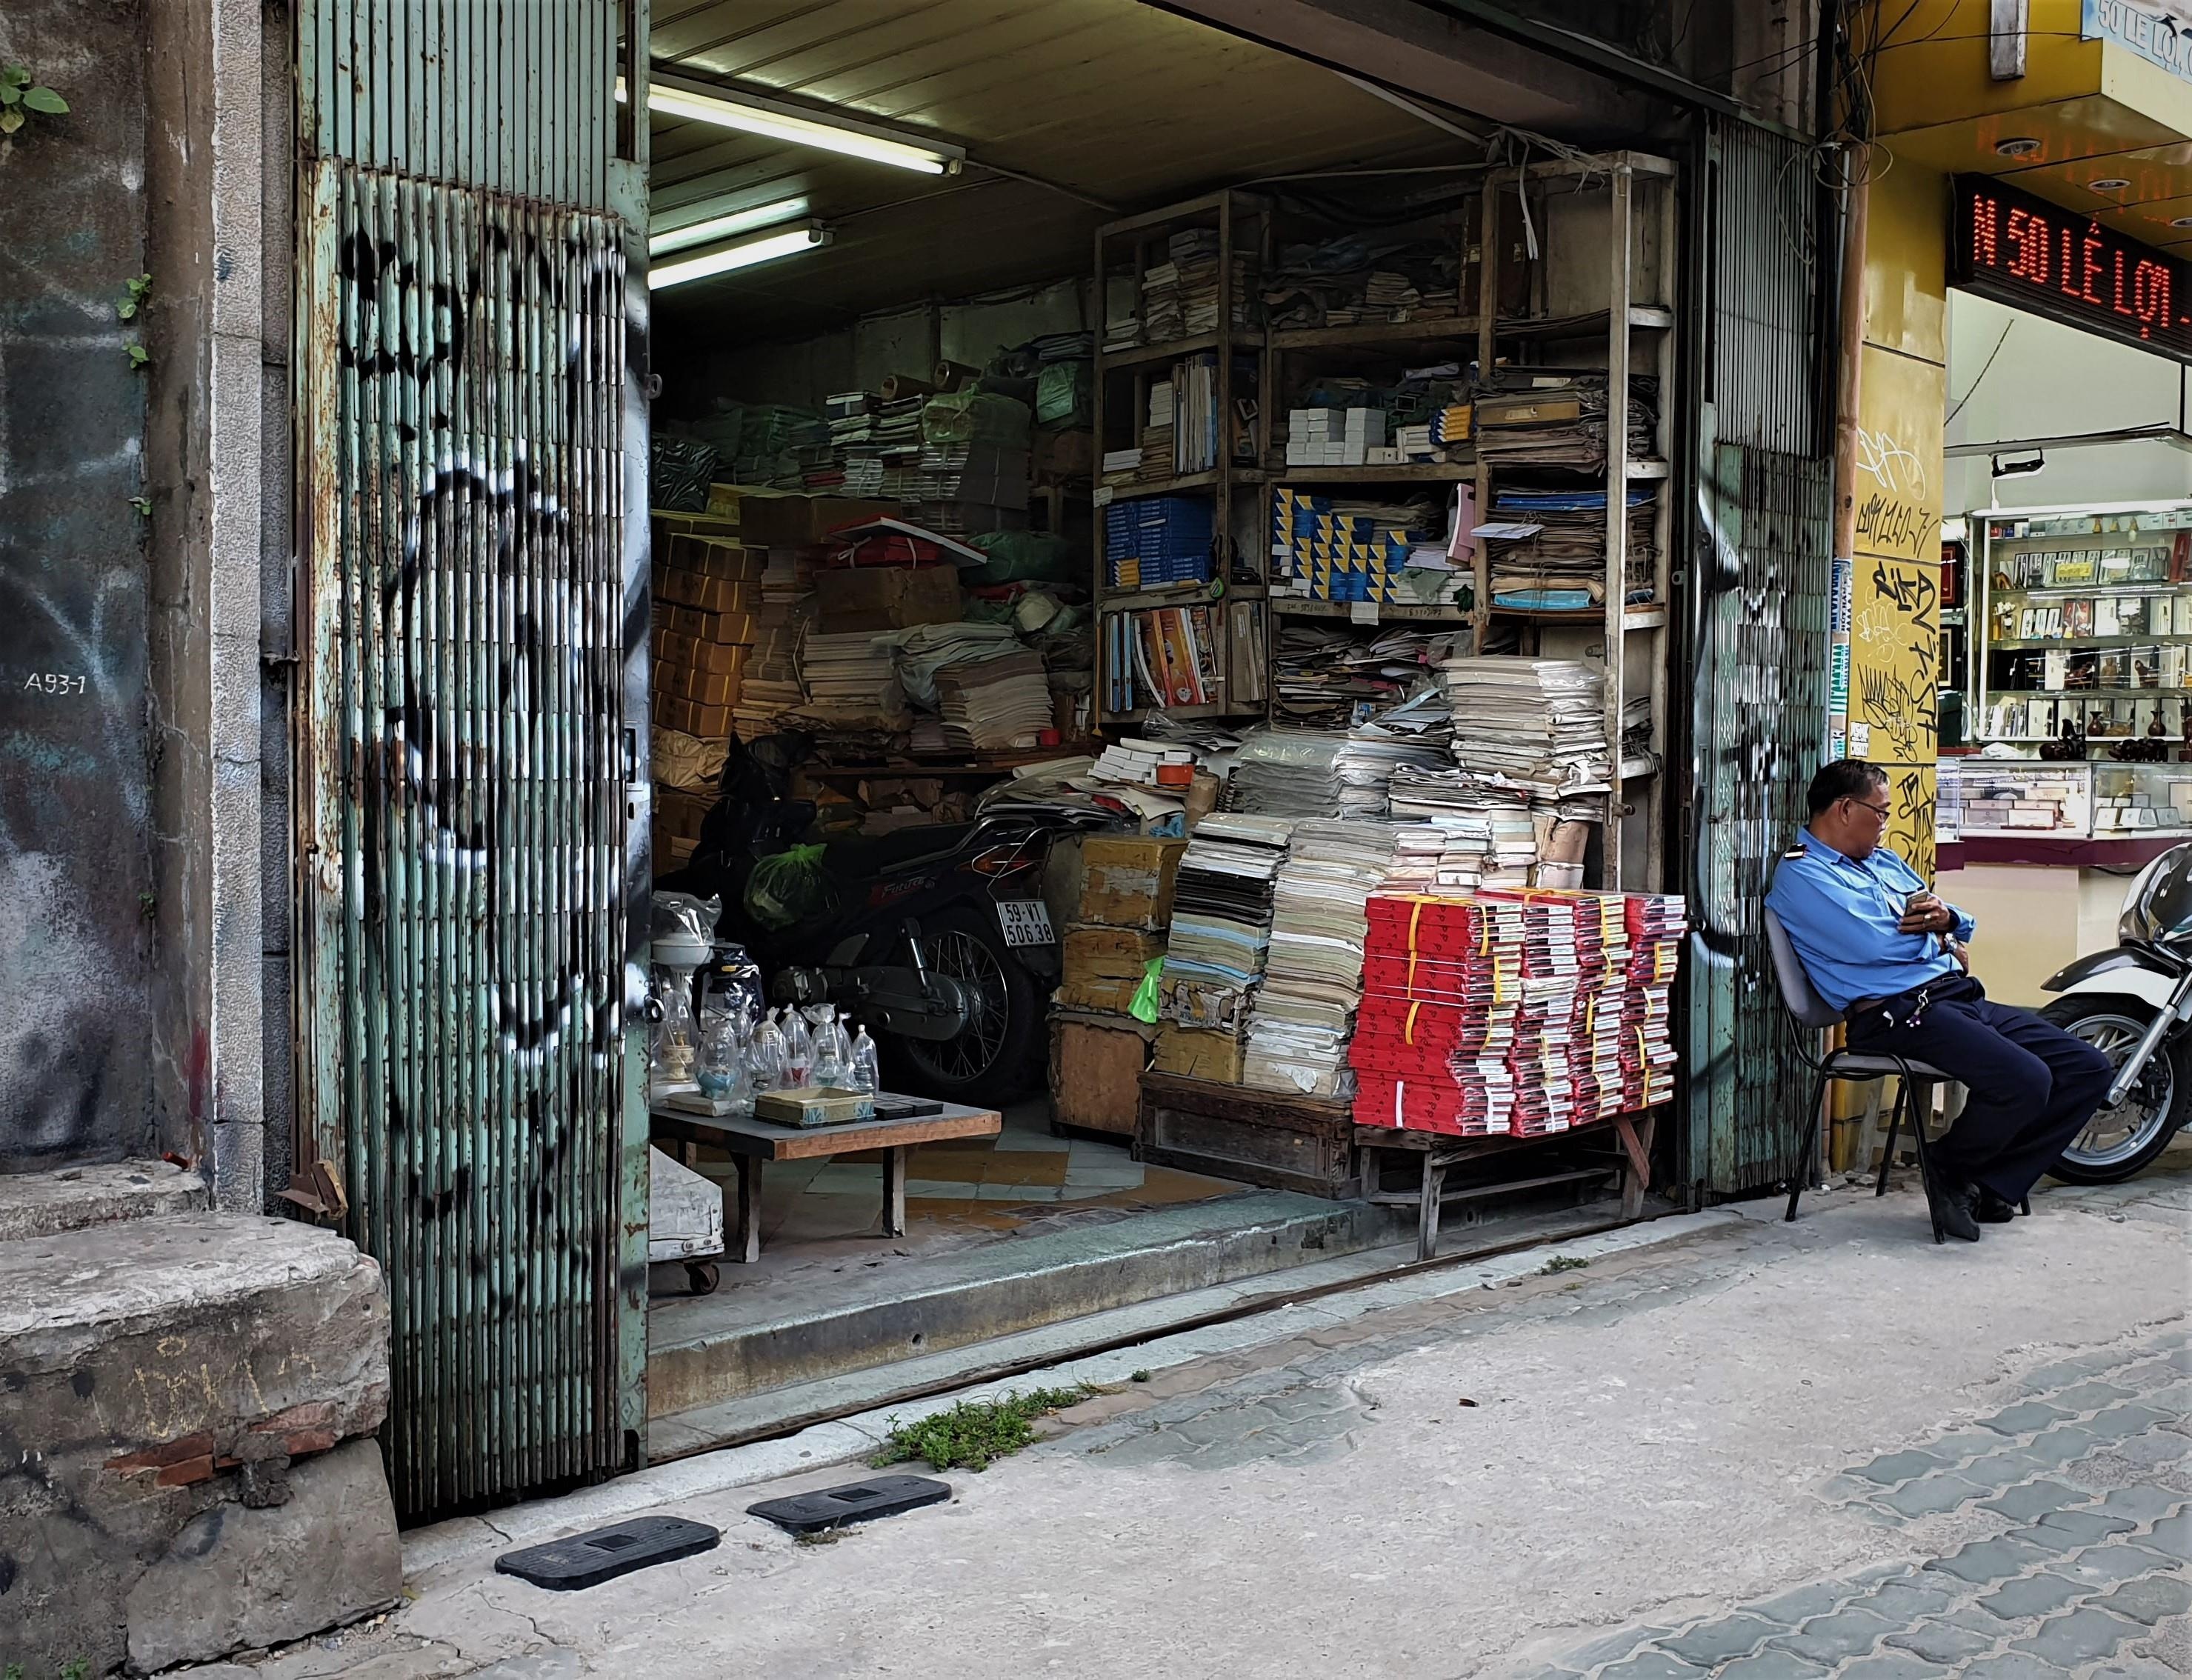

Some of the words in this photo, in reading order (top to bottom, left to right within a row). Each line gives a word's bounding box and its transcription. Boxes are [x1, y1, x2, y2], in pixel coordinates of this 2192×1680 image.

[2098, 0, 2119, 34] 50
[2006, 207, 2050, 284] 50
[2061, 221, 2103, 304] LÊ
[24, 672, 87, 695] A93-1
[1005, 902, 1042, 922] 59-V1
[1007, 923, 1053, 944] 506.38
